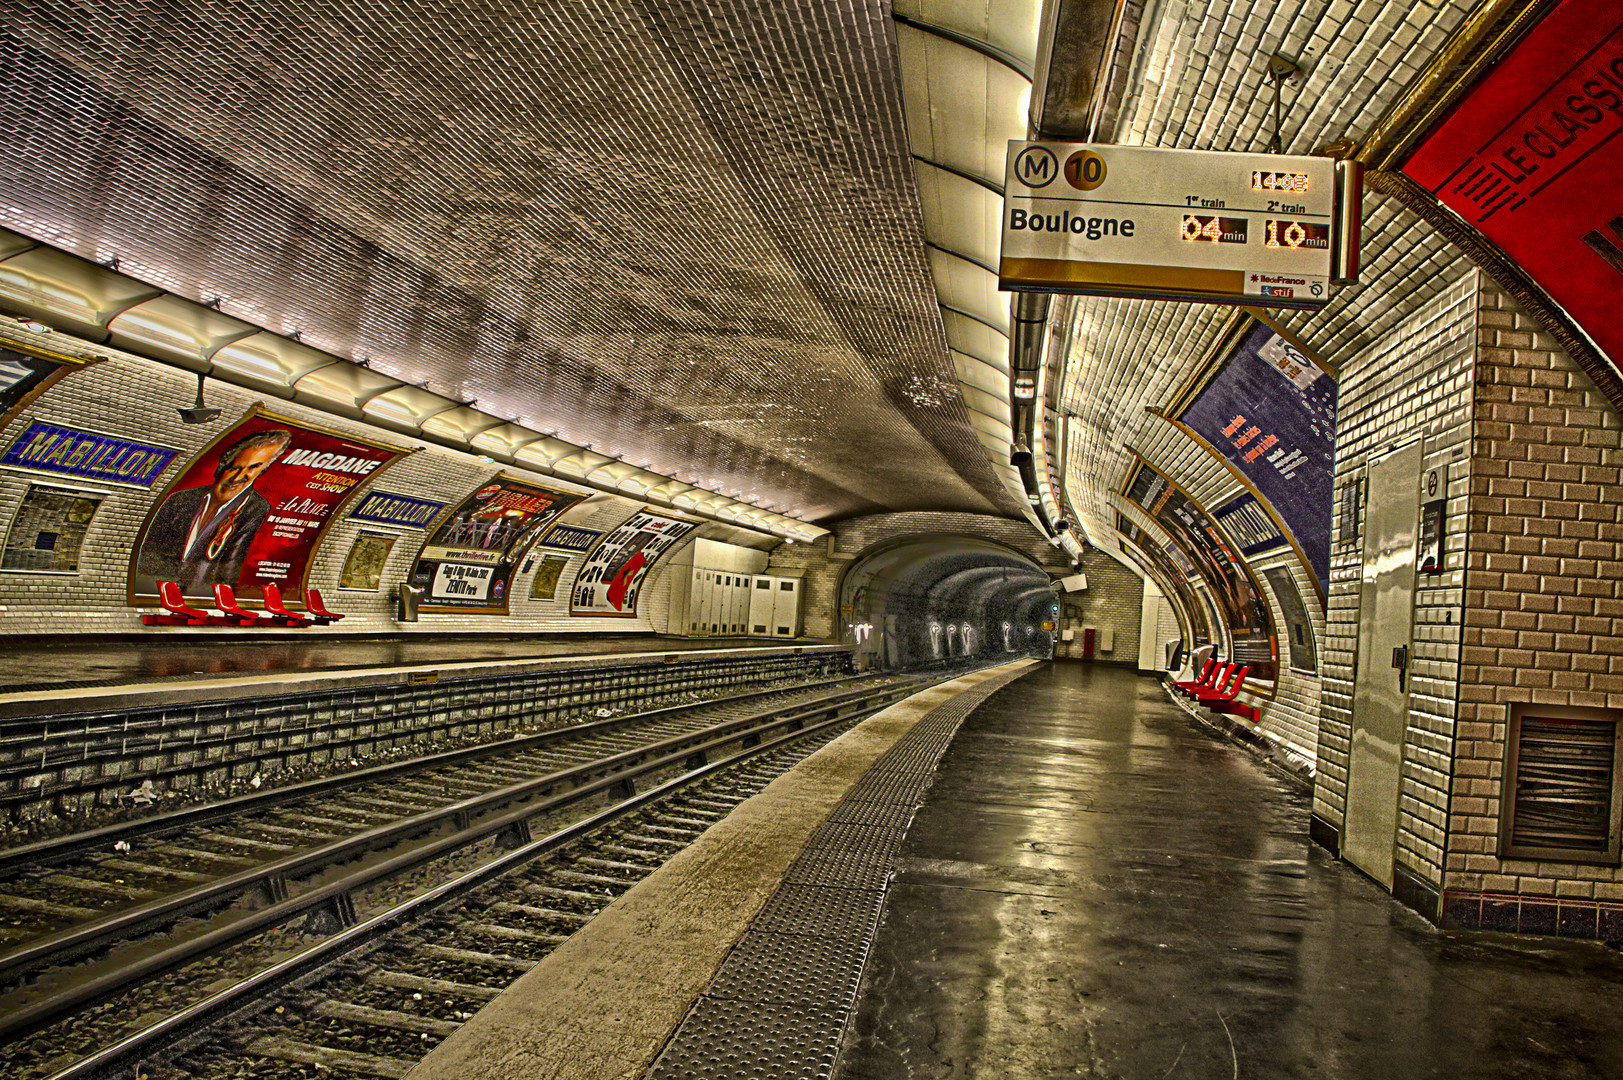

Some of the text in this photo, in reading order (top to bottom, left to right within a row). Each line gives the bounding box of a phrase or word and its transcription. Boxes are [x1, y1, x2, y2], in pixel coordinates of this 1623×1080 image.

[1024, 154, 1102, 183] M 10
[1490, 146, 1540, 185] LE
[1200, 198, 1226, 208] train
[1281, 203, 1306, 214] train
[1010, 208, 1135, 240] Boulogne
[1181, 214, 1246, 244] 04 min
[1266, 219, 1328, 249] 10 min
[1273, 287, 1293, 298] stif
[18, 432, 165, 478] MABILLON
[282, 448, 382, 474] MAGDANE
[312, 472, 358, 487] ATTENTION
[320, 483, 348, 494] SHOW
[283, 496, 299, 511] Le
[358, 496, 439, 524] MABILLON
[487, 489, 553, 514] THRILLER
[1219, 500, 1281, 549] MABILLON
[546, 528, 597, 549] MABILLON
